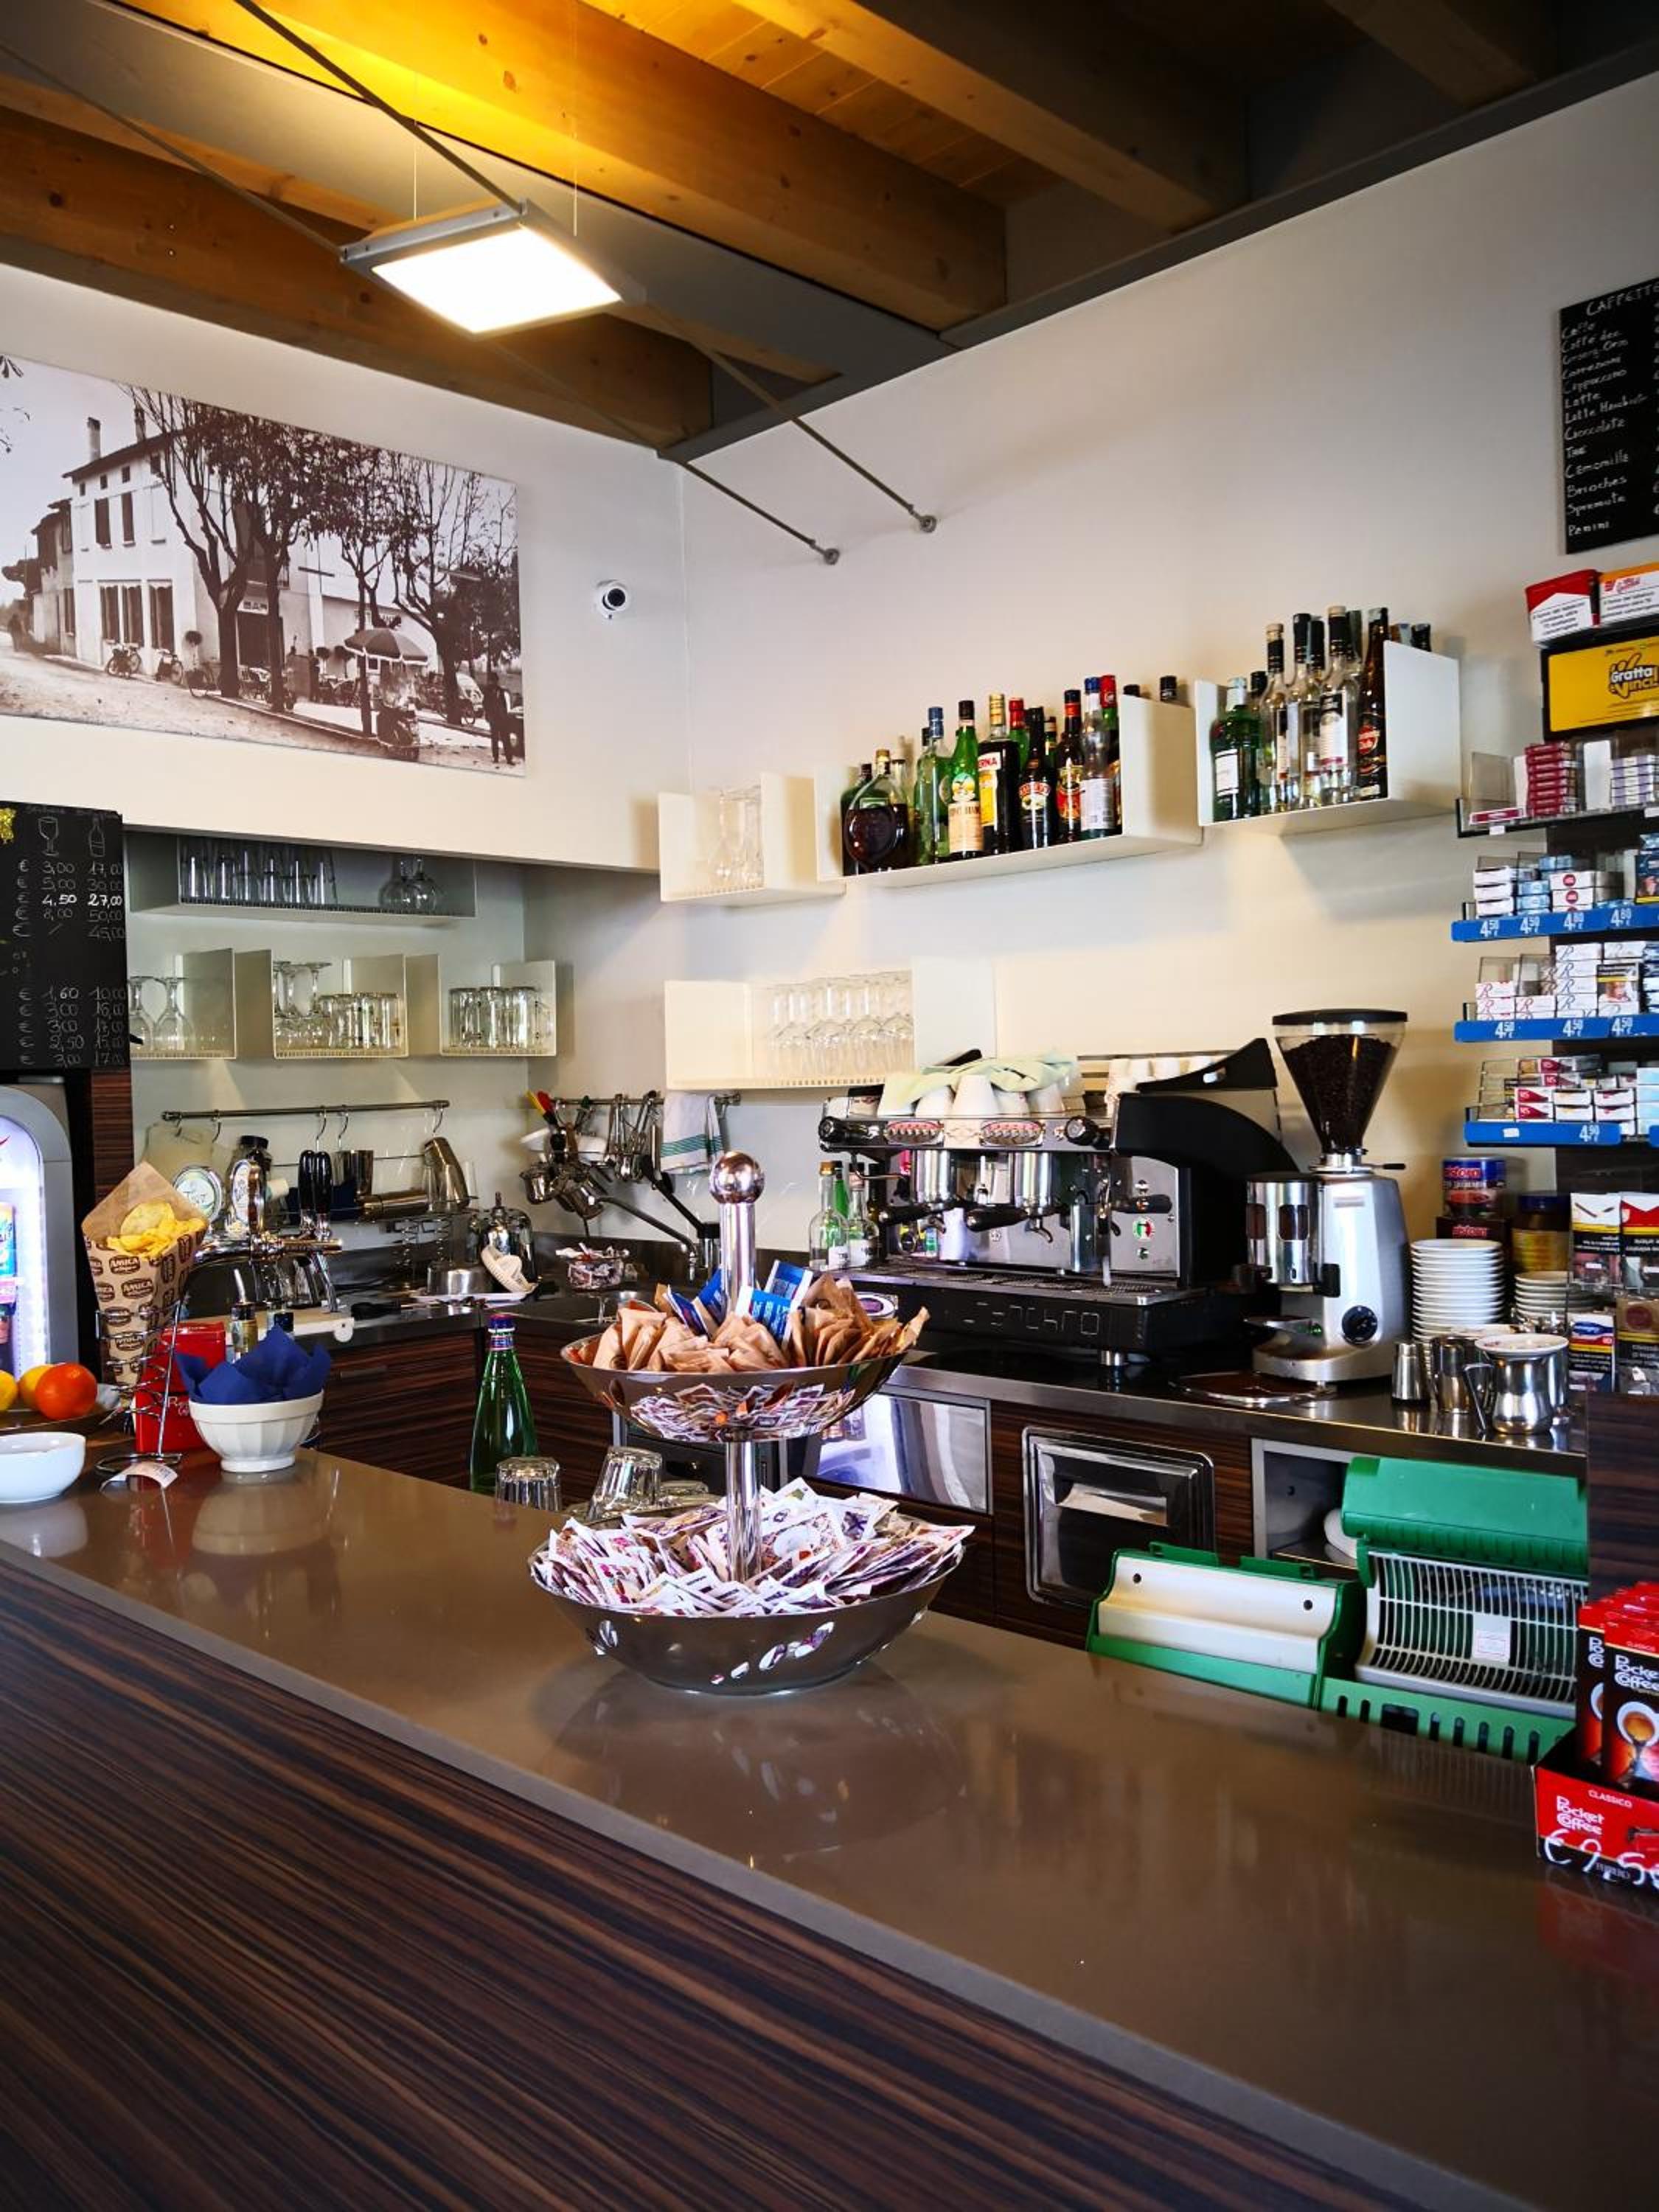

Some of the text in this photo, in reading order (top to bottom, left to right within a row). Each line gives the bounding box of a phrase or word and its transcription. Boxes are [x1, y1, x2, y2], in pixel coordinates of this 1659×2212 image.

[1568, 521, 1610, 536] Panini
[1610, 665, 1652, 683] Gratta
[123, 1282, 153, 1294] AMICA
[1615, 1654, 1659, 1679] Pocke
[1587, 1789, 1633, 1809] CLASSICO
[1557, 1795, 1604, 1824] Pocket
[1557, 1812, 1602, 1836] Coffee
